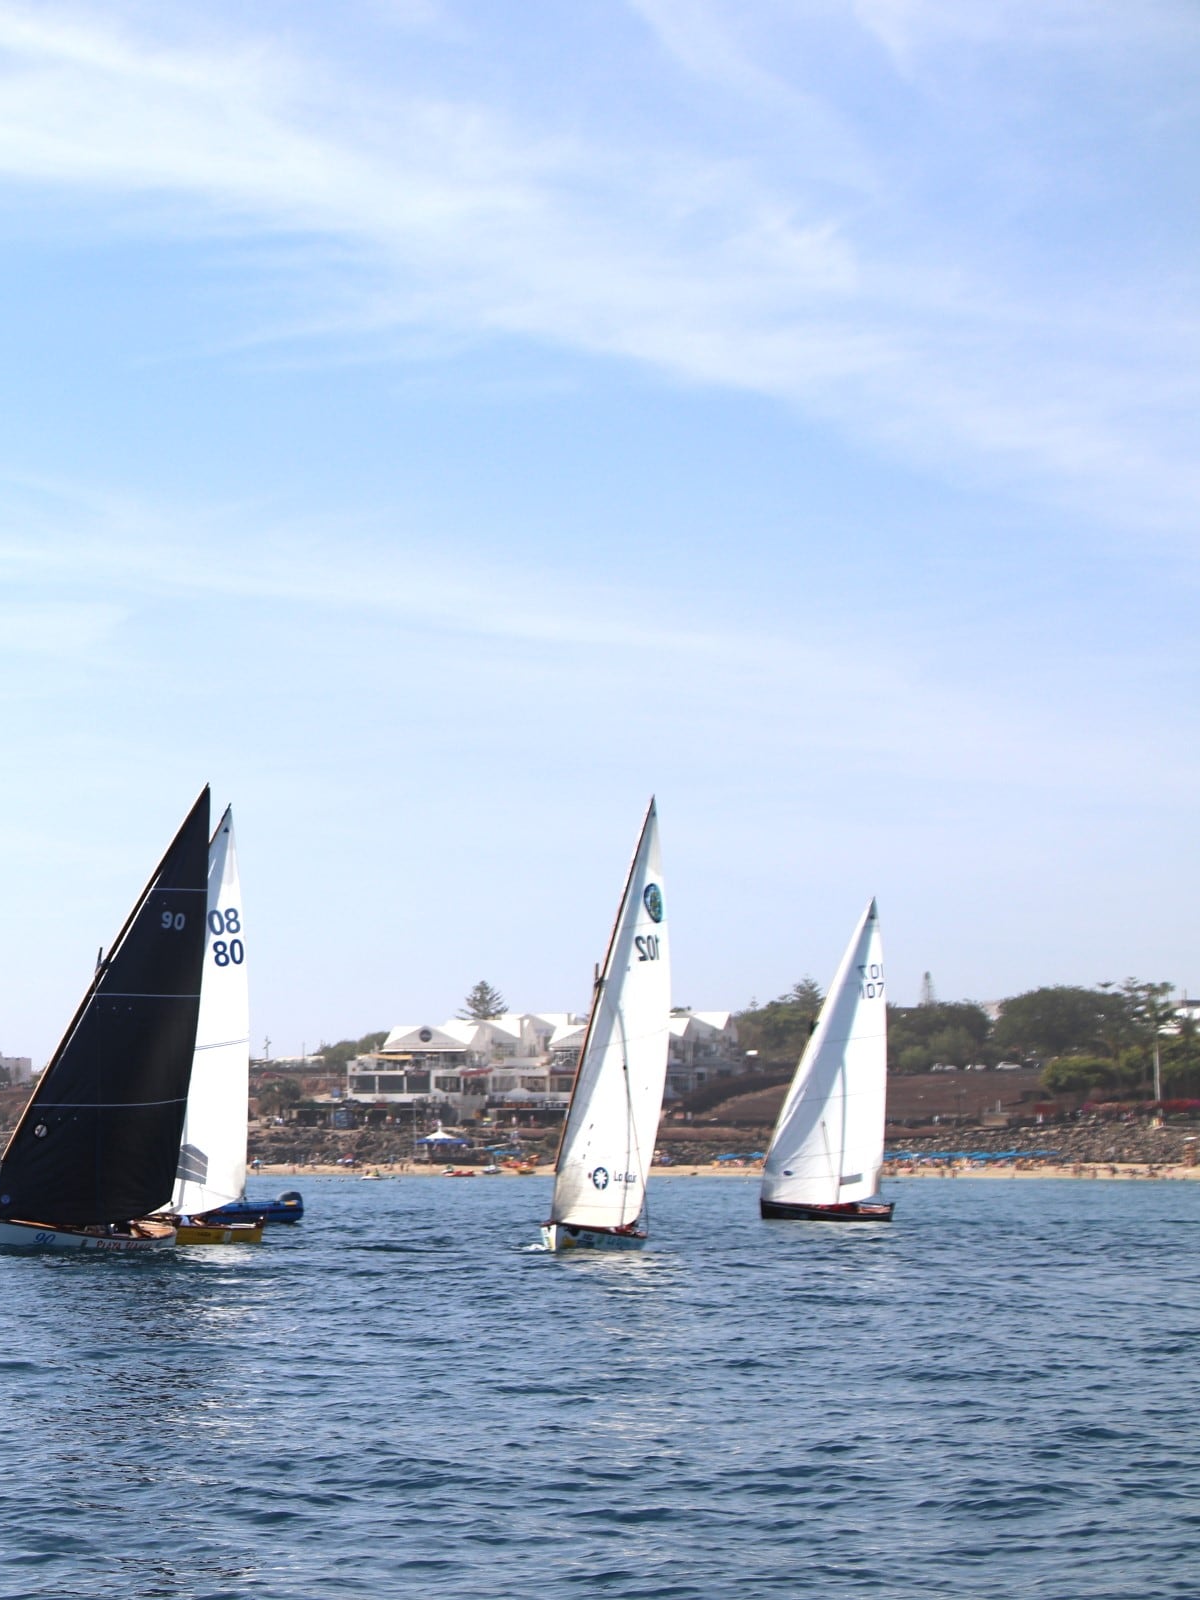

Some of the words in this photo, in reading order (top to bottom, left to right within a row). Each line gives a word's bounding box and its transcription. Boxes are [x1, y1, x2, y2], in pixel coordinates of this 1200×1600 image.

[161, 911, 185, 930] 90
[213, 939, 244, 967] 80
[33, 1232, 56, 1244] 90
